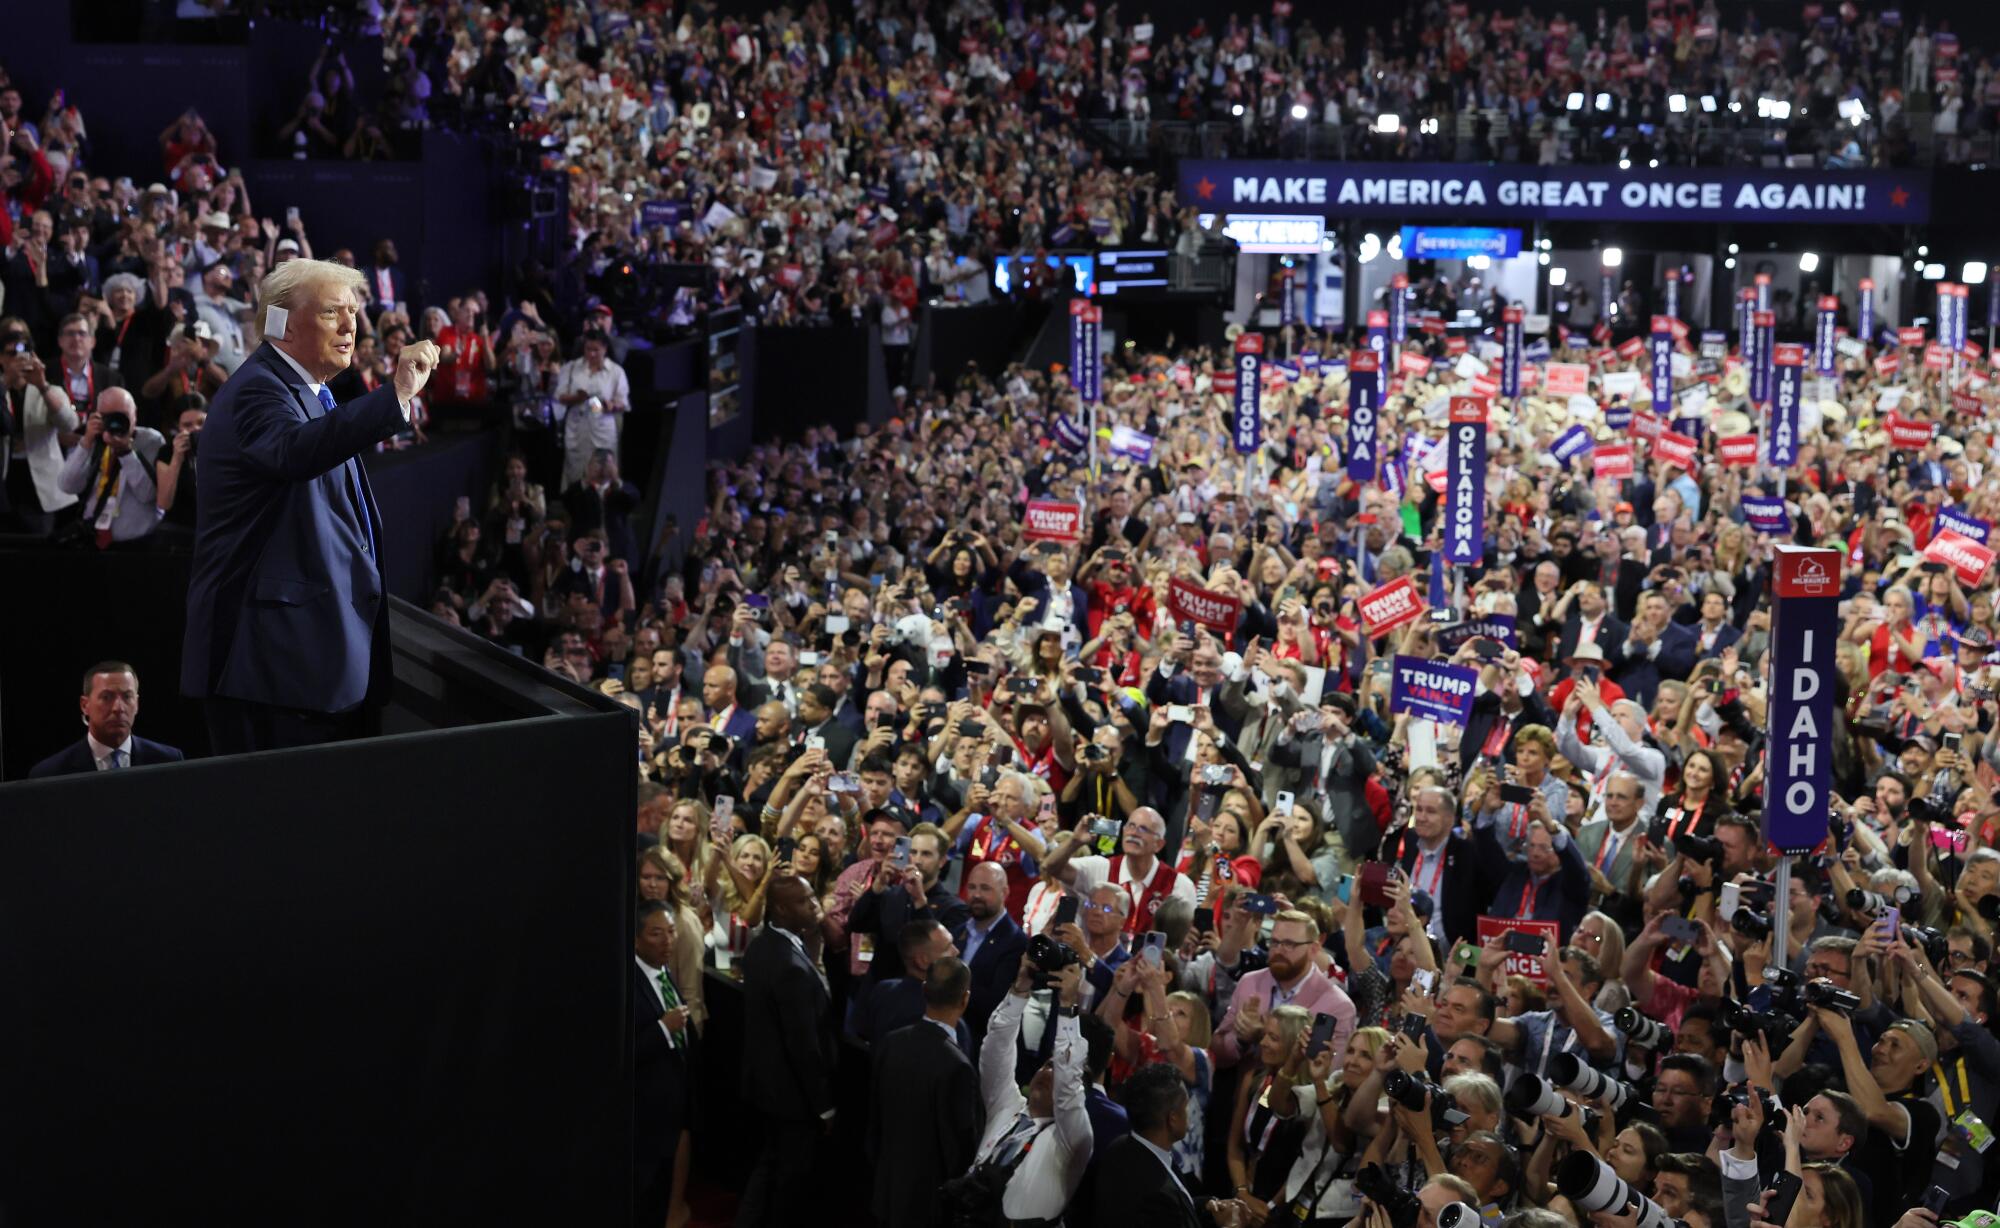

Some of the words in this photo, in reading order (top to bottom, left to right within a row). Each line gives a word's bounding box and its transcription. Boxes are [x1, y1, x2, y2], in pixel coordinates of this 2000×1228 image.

[1233, 178, 1327, 204] MAKE
[1337, 178, 1486, 205] AMERICA
[1497, 180, 1609, 206] GREAT
[1619, 182, 1722, 208] ONCE
[1734, 183, 1866, 209] AGAIN!
[1259, 221, 1319, 243] NEWS
[1655, 341, 1670, 402] MAINE
[1238, 355, 1257, 446] OREGON
[1778, 367, 1796, 461] INDIANA
[1351, 389, 1375, 460] IOWA
[1454, 426, 1476, 556] OKLAHOMA
[1030, 508, 1076, 523] TRUMP
[1033, 519, 1070, 531] VANCE
[1938, 513, 1985, 539] TRUMP
[1936, 538, 1985, 570] TRUMP
[1172, 585, 1234, 615] TRUMP
[1178, 597, 1224, 622] VANCE
[1362, 586, 1411, 617] TRUMP
[1370, 598, 1411, 624] VANCE
[1400, 668, 1471, 697] TRUMP
[1408, 684, 1463, 708] VANCE
[1785, 629, 1821, 815] IDAHO
[1506, 958, 1542, 975] NCE
